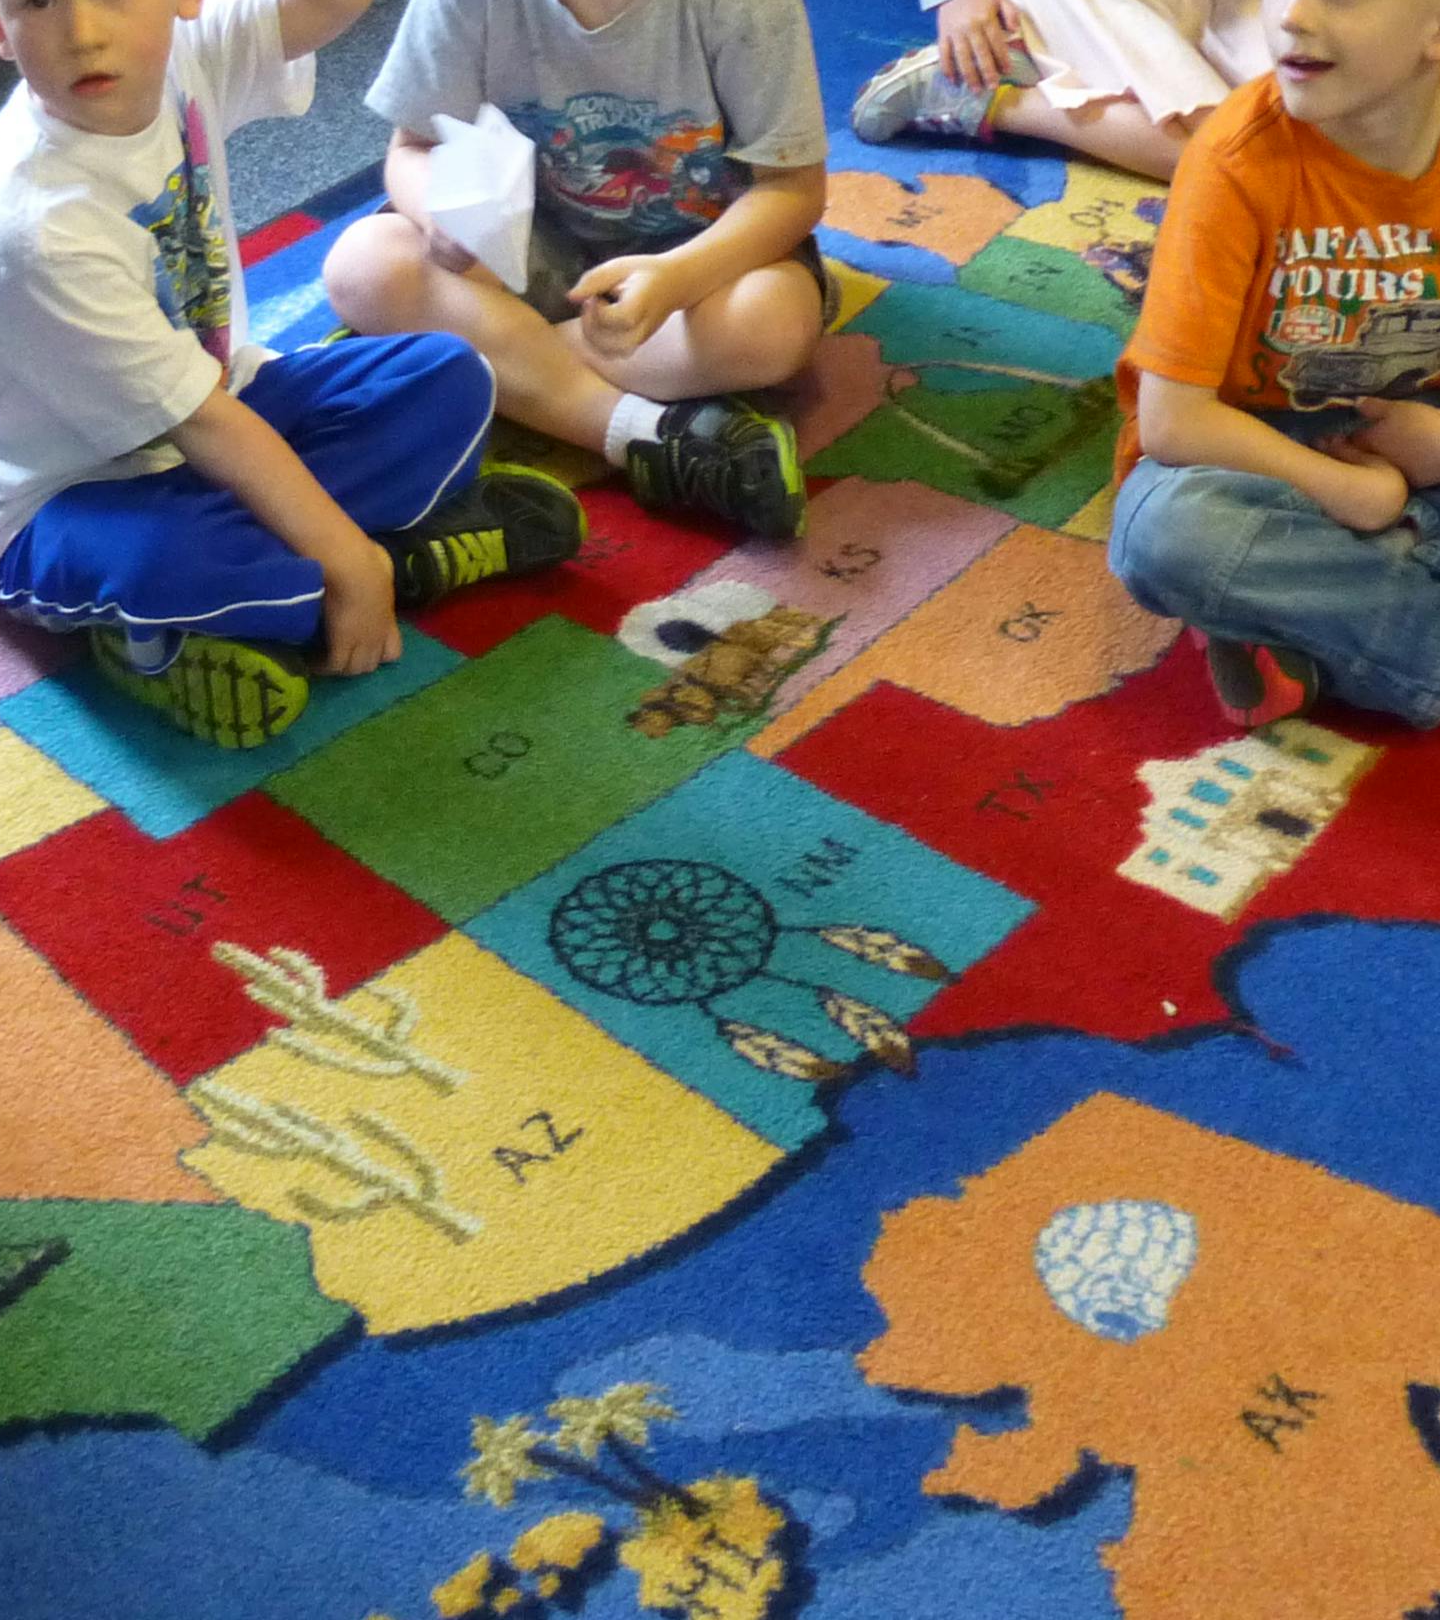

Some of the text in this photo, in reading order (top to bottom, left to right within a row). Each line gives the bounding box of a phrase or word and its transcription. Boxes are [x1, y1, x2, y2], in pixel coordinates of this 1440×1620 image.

[463, 731, 534, 780] CO
[975, 770, 1056, 822] TX
[492, 1109, 585, 1185] AZ
[1240, 1373, 1326, 1453] AK
